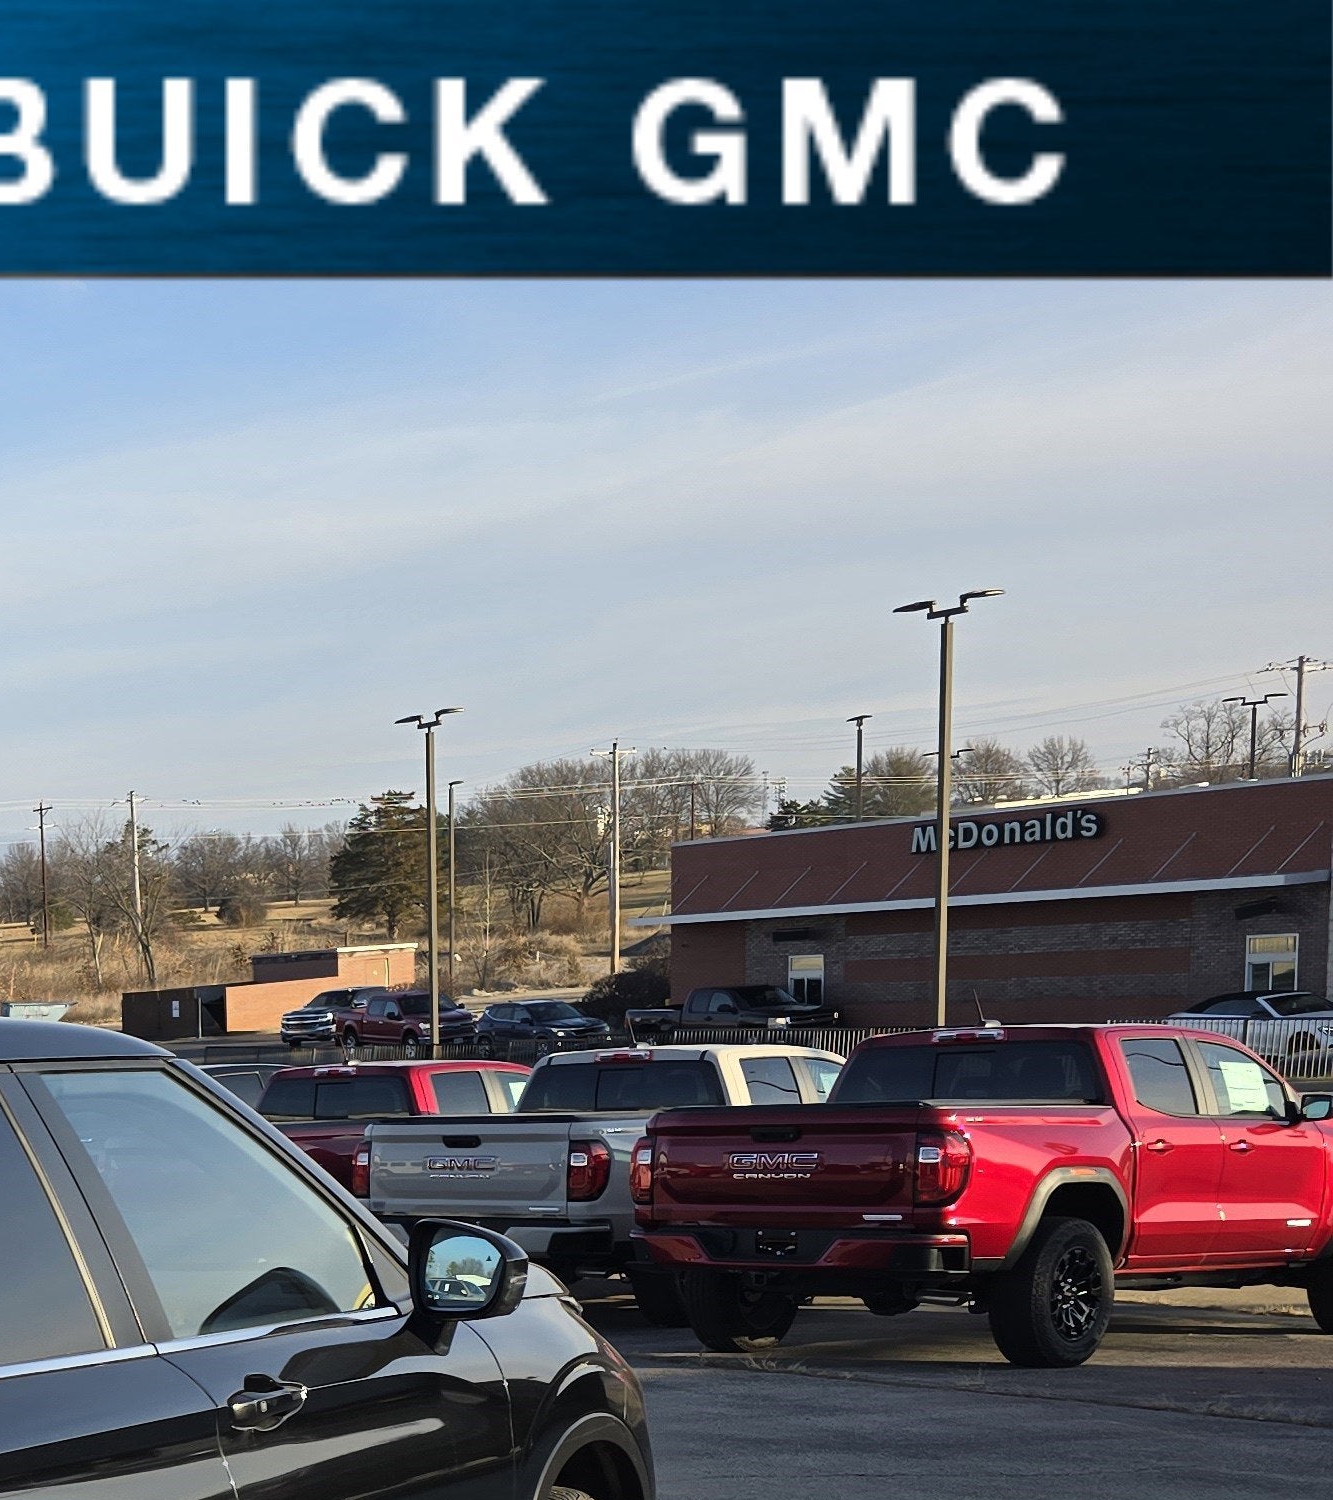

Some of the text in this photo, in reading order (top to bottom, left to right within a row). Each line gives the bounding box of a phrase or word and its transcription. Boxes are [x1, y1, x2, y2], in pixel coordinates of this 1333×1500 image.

[427, 1156, 497, 1172] GMC
[729, 1152, 819, 1171] GMC
[732, 1172, 812, 1180] CANYON
